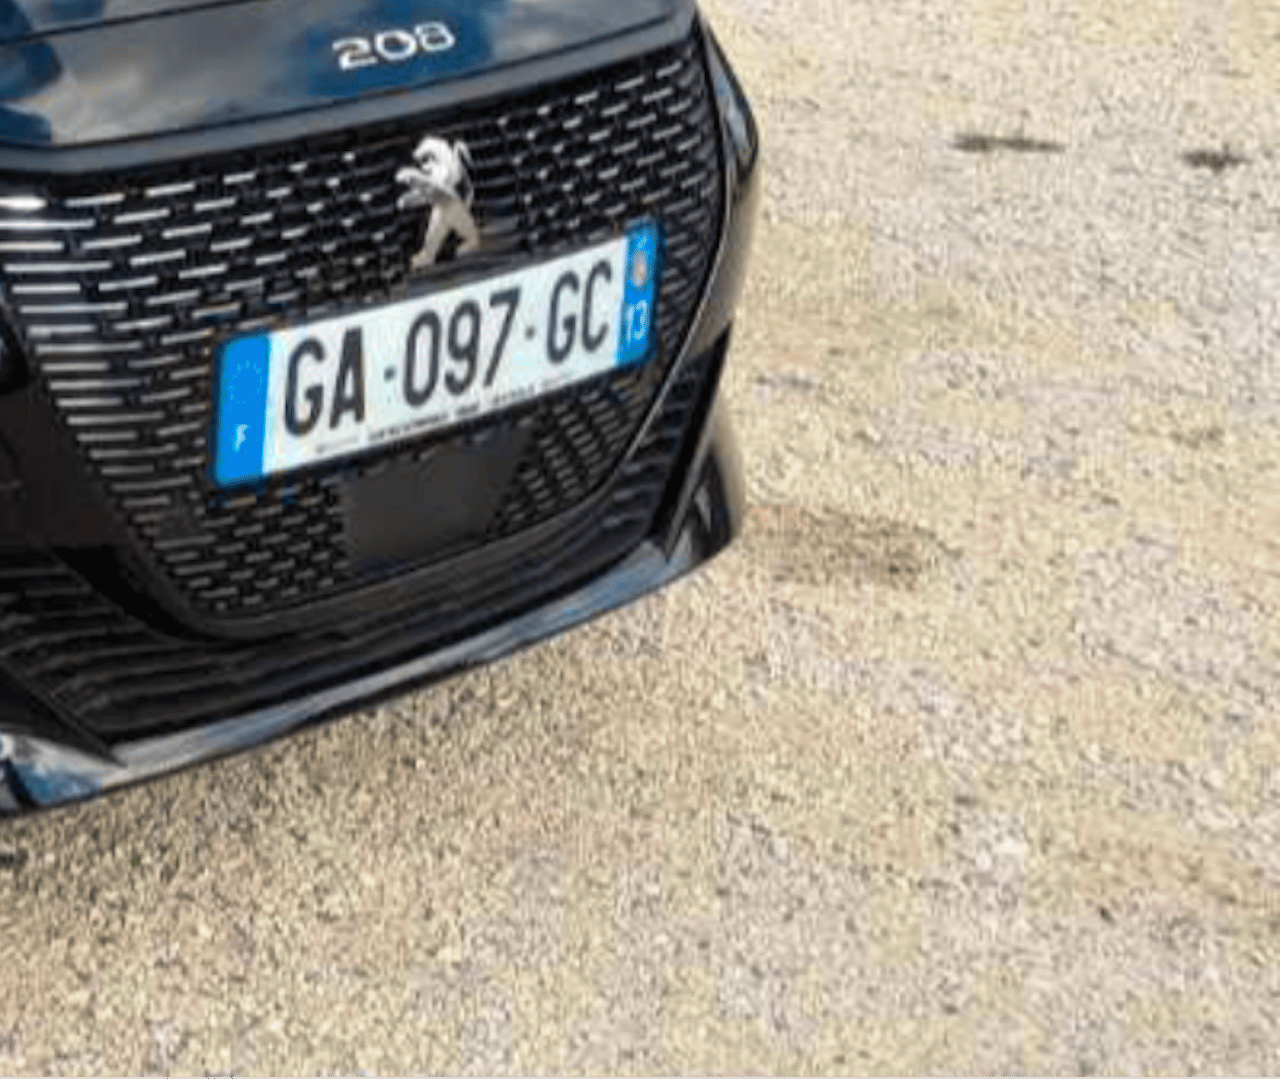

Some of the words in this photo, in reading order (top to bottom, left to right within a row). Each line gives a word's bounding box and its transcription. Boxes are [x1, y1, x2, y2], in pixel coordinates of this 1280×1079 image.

[331, 21, 456, 71] 208
[624, 299, 647, 344] 13
[231, 423, 249, 453] F
